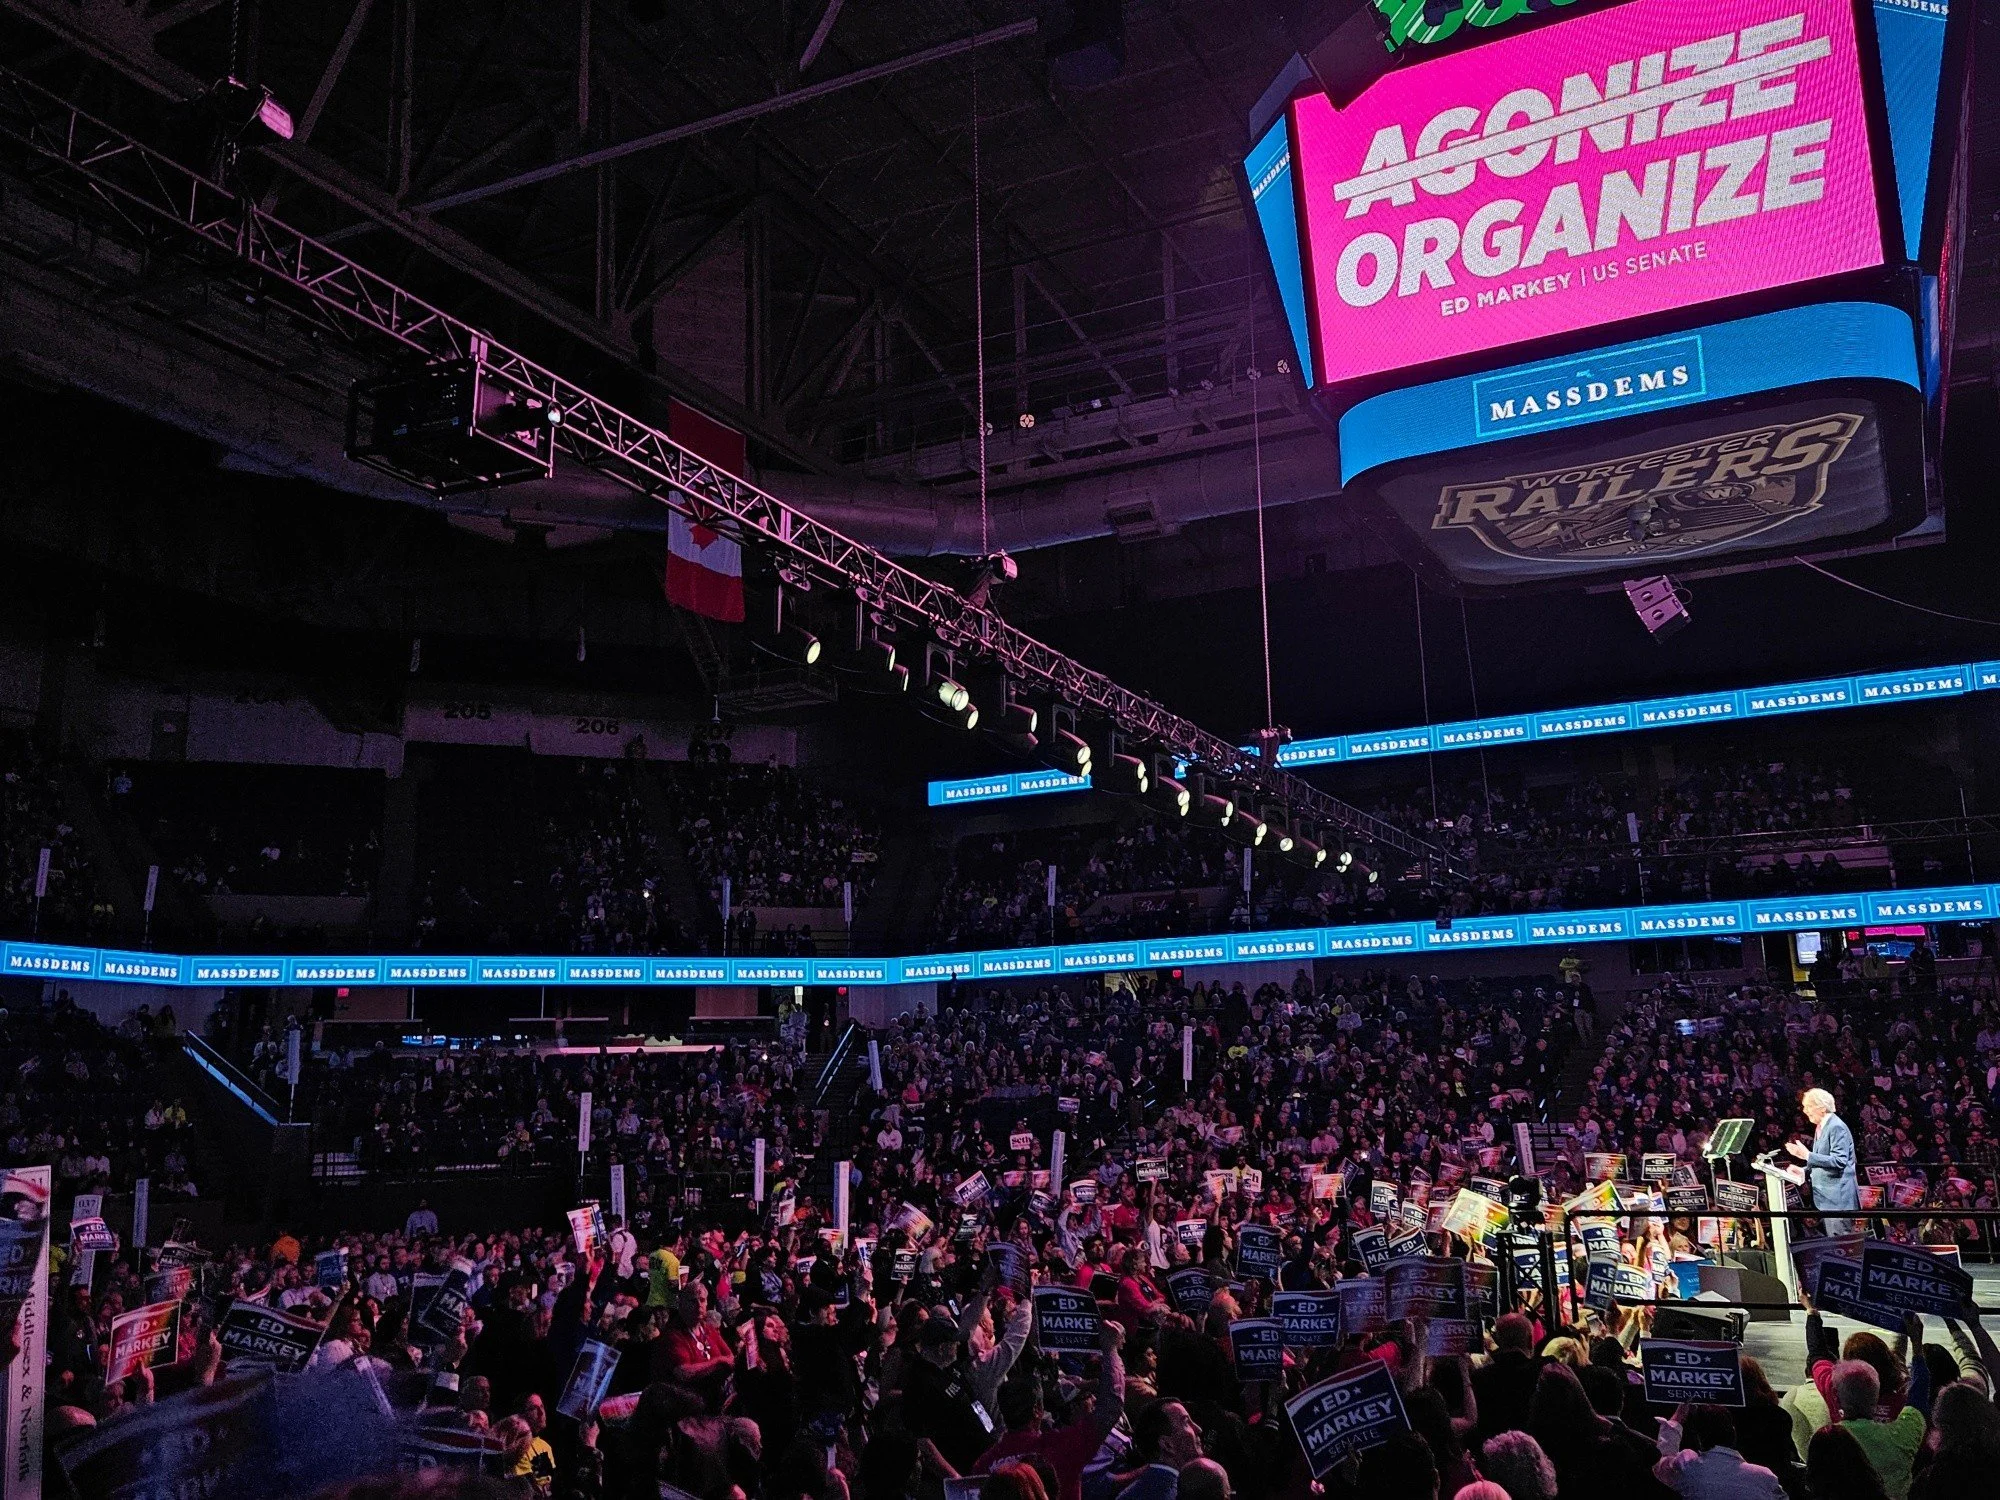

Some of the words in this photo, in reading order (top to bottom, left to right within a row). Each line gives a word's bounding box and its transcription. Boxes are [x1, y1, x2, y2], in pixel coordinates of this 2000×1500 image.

[1344, 13, 1808, 219] AGONIZE
[1335, 119, 1831, 307] ORGANIZE
[1440, 296, 1470, 317] ED
[1477, 273, 1572, 309] MARKEY
[1592, 261, 1620, 283] US
[1626, 241, 1708, 275] SENATE
[1490, 364, 1689, 421] MASSDEMS
[1521, 430, 1773, 489] WORCESTER
[1449, 420, 1843, 525] RAILERS
[1864, 676, 1963, 698] MASSDEMS
[1752, 690, 1847, 710] MASSDEMS
[1643, 703, 1733, 722] MASSDEMS
[1541, 715, 1626, 733] MASSDEMS
[1443, 725, 1524, 743] MASSDEMS
[1352, 736, 1429, 754] MASSDEMS
[1021, 776, 1085, 790] MASSDEMS
[946, 784, 1008, 799] MASSDEMS
[1878, 900, 1983, 916] MASSDEMS
[1641, 915, 1736, 931] MASSDEMS
[1756, 908, 1857, 924] MASSDEMS
[1429, 929, 1514, 943] MASSDEMS
[1532, 922, 1623, 938] MASSDEMS
[1238, 941, 1315, 955] MASSDEMS
[1331, 935, 1413, 949] MASSDEMS
[1064, 952, 1135, 966] MASSDEMS
[1149, 947, 1223, 960] MASSDEMS
[11, 956, 90, 972] MASSDEMS
[105, 962, 177, 978] MASSDEMS
[905, 964, 970, 976] MASSDEMS
[983, 959, 1051, 972] MASSDEMS
[198, 968, 280, 979] MASSDEMS
[296, 968, 376, 979] MASSDEMS
[390, 968, 467, 978] MASSDEMS
[482, 968, 556, 978] MASSDEMS
[570, 968, 641, 978] MASSDEMS
[655, 969, 724, 979] MASSDEMS
[737, 969, 803, 979] MASSDEMS
[817, 969, 882, 979] MASSDEMS
[1645, 1166, 1673, 1174] MARKEY
[1670, 1198, 1705, 1206] MARKEY
[1719, 1192, 1756, 1205] MARKEY
[1258, 1236, 1270, 1245] ED
[1402, 1242, 1414, 1252] ED
[1903, 1257, 1935, 1274] ED
[1628, 1272, 1643, 1283] ED
[1391, 1286, 1457, 1300] MARKEY
[1059, 1299, 1078, 1310] ED
[1298, 1302, 1317, 1313] ED
[133, 1320, 150, 1335] ED
[257, 1318, 285, 1335] ED
[1042, 1315, 1098, 1331] MARKE
[1261, 1330, 1279, 1342] ED
[116, 1332, 172, 1359] MARKEY
[223, 1330, 306, 1362] MARKEY
[1675, 1352, 1702, 1365] ED
[1651, 1369, 1735, 1386] MARKEY
[21, 1384, 32, 1402] &
[1321, 1388, 1351, 1412] ED
[1668, 1389, 1717, 1400] SENATE
[1306, 1397, 1392, 1450] MARKEY
[1328, 1428, 1380, 1459] SENATE
